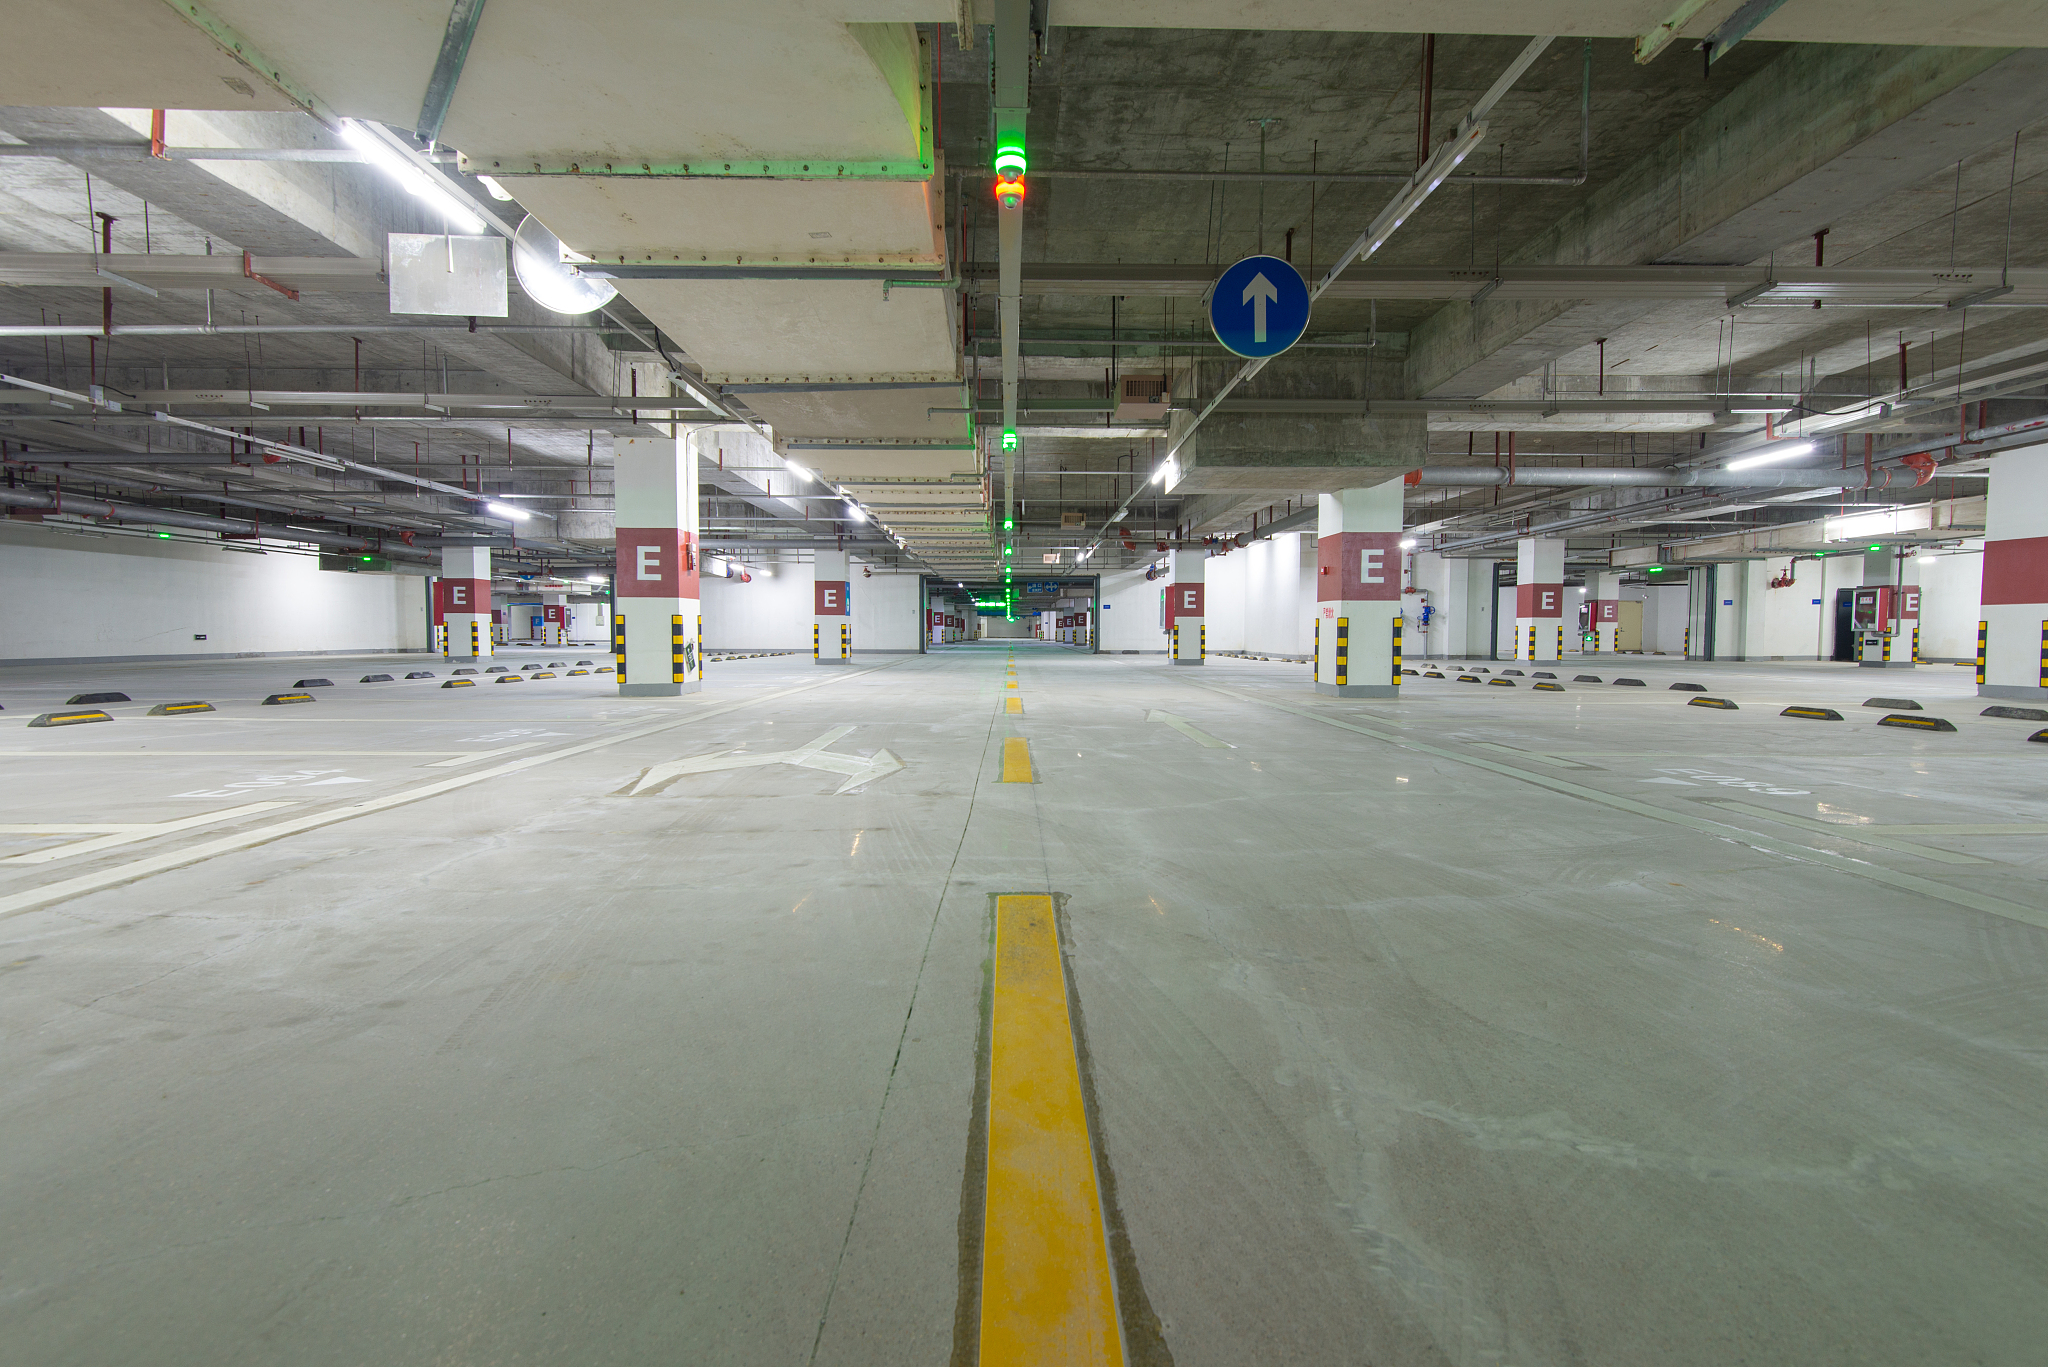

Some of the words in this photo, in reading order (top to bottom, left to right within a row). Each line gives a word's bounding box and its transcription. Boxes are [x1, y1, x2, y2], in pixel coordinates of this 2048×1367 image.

[637, 546, 661, 580] E
[1361, 549, 1384, 583] E
[453, 587, 466, 604] E
[824, 590, 837, 607] E
[1184, 591, 1196, 608] E
[1542, 592, 1554, 609] E
[1906, 594, 1918, 611] E
[548, 609, 556, 619] E
[935, 615, 940, 623] E
[1604, 606, 1612, 617] E
[167, 768, 348, 798] E094
[1651, 768, 1811, 795] E089
